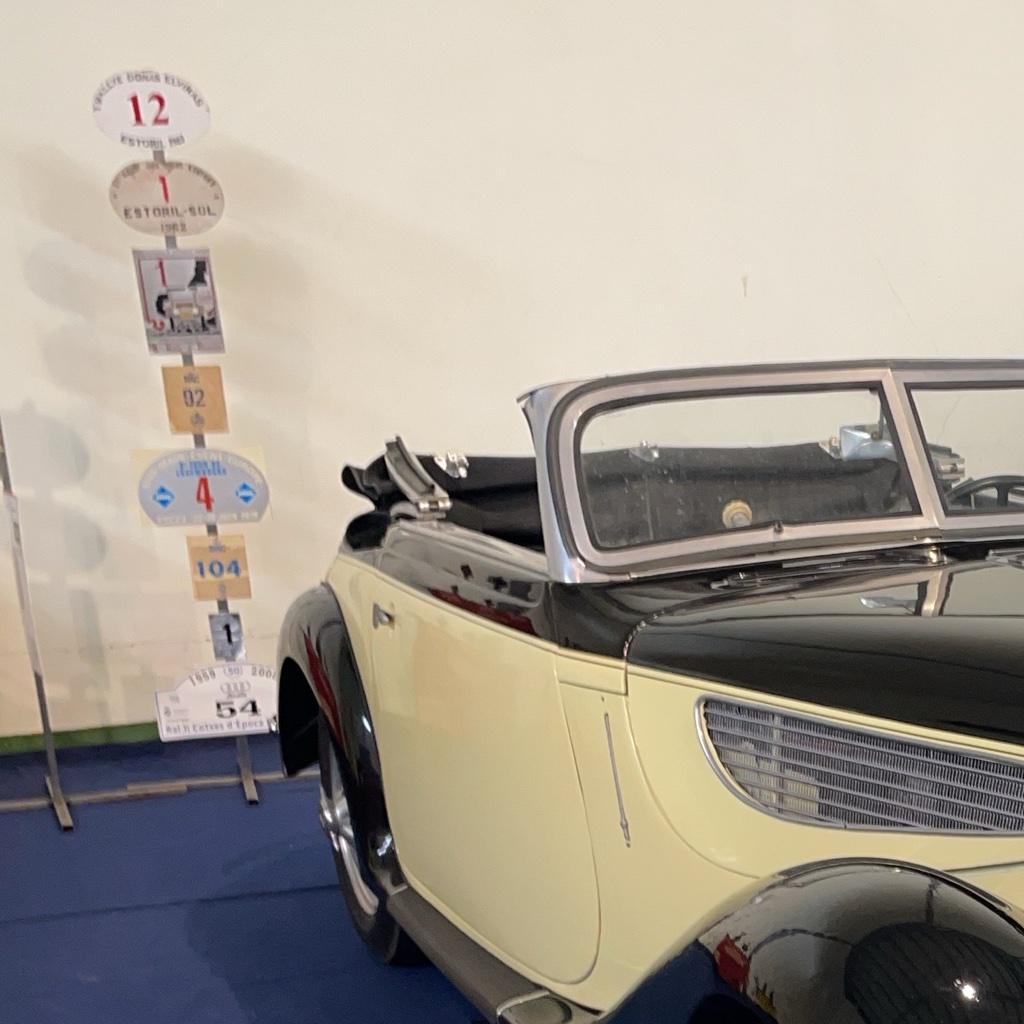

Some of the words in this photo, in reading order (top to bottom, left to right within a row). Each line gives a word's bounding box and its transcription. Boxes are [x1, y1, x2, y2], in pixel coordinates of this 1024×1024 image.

[127, 91, 170, 127] 12
[157, 174, 169, 204] 1
[123, 204, 218, 220] ESTORIL-SOL
[196, 475, 214, 513] 4
[196, 558, 240, 578] 104
[222, 622, 233, 646] 1
[215, 699, 263, 719] 54
